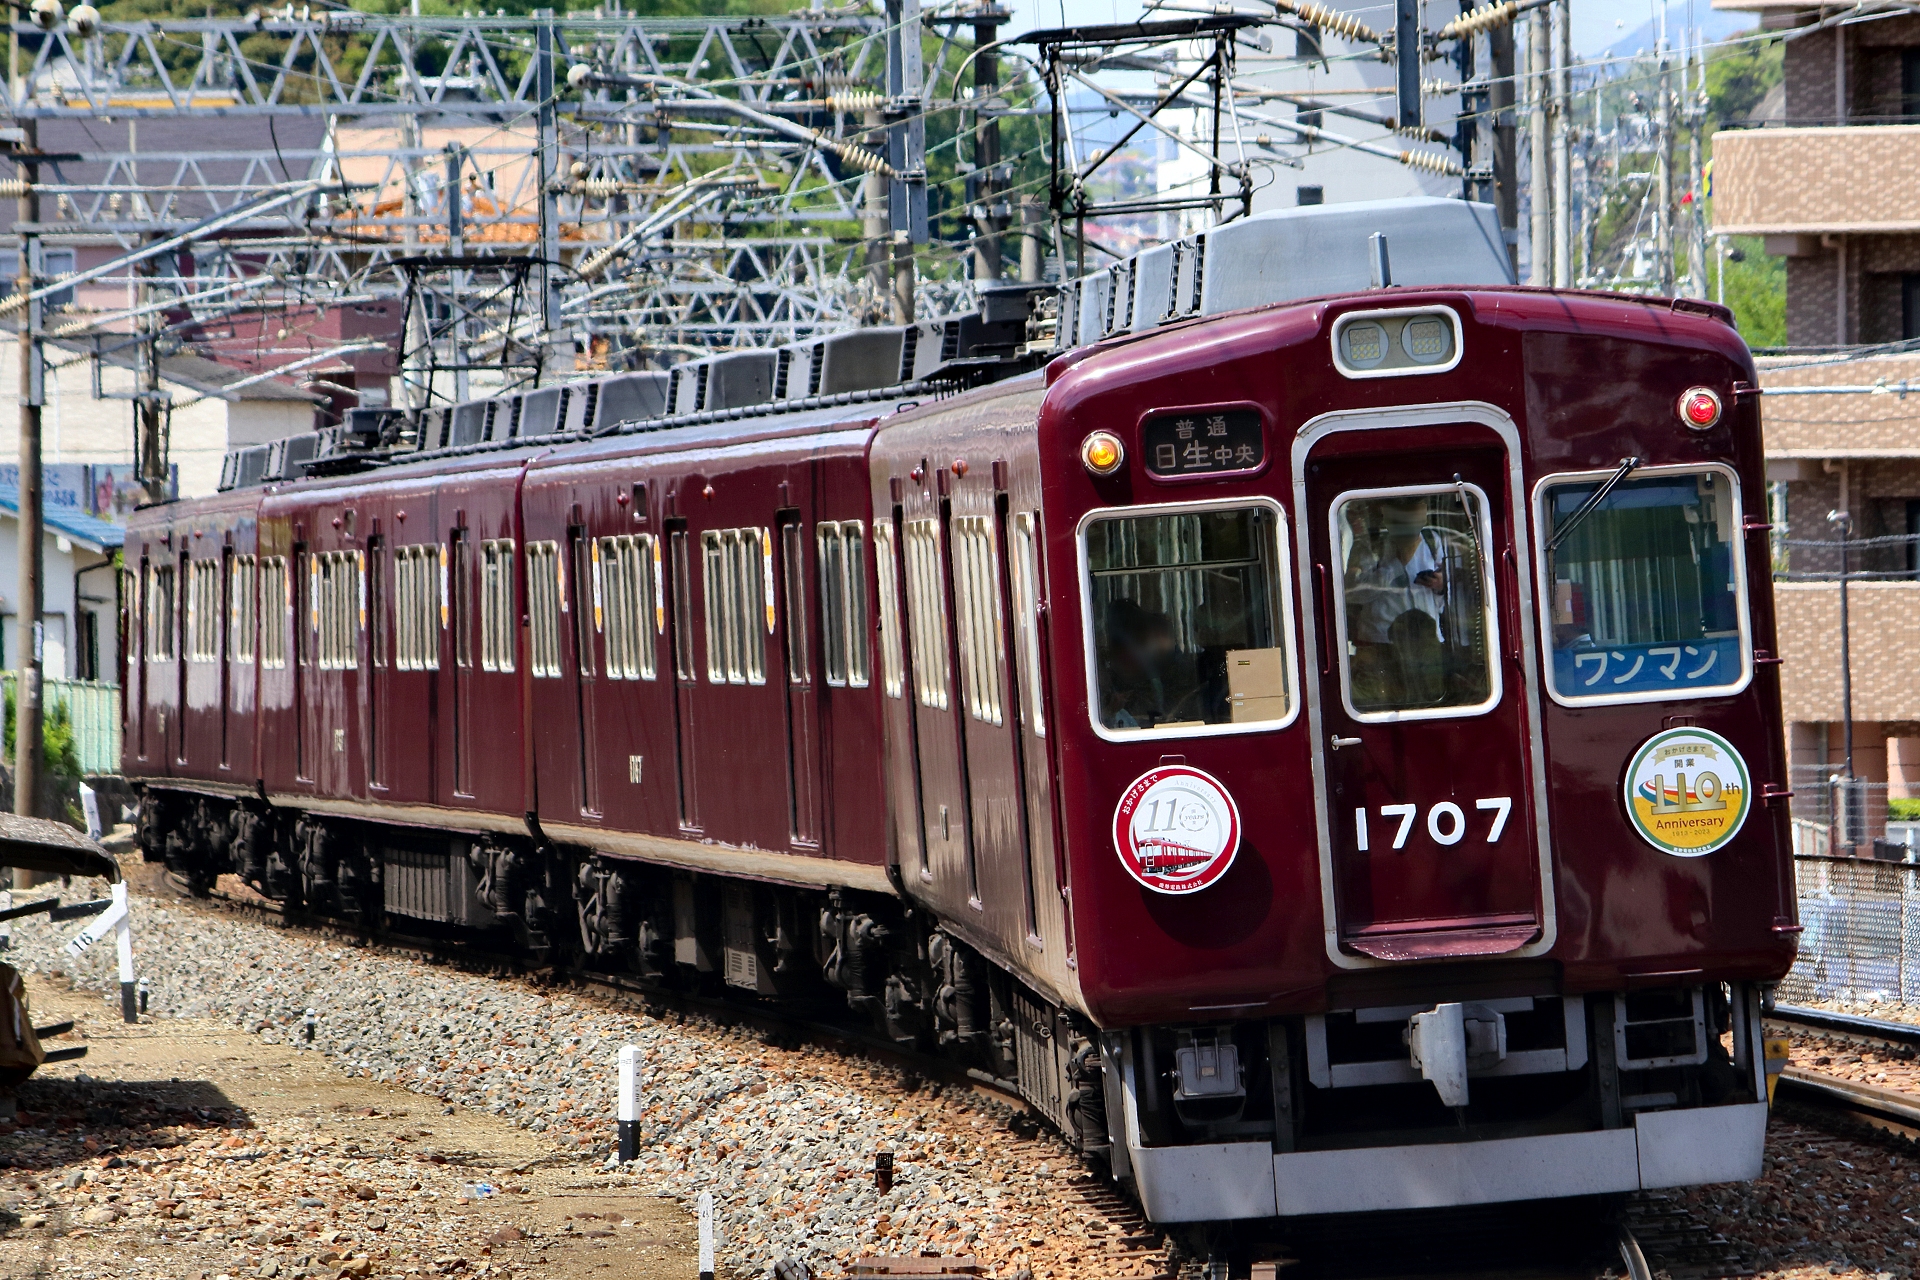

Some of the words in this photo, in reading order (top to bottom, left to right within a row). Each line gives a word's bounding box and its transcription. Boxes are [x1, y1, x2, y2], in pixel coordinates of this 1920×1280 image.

[1175, 415, 1228, 440] 普通
[1155, 439, 1255, 469] 日生中央
[1574, 645, 1718, 686] ワンマン
[1664, 746, 1706, 756] おかげさまで
[1674, 758, 1695, 768] 開業
[1122, 774, 1158, 814] おかげさまで
[1174, 780, 1217, 803] Anniversary
[1184, 813, 1204, 822] years
[1355, 796, 1512, 851] 1707
[1656, 817, 1724, 830] Anniversary
